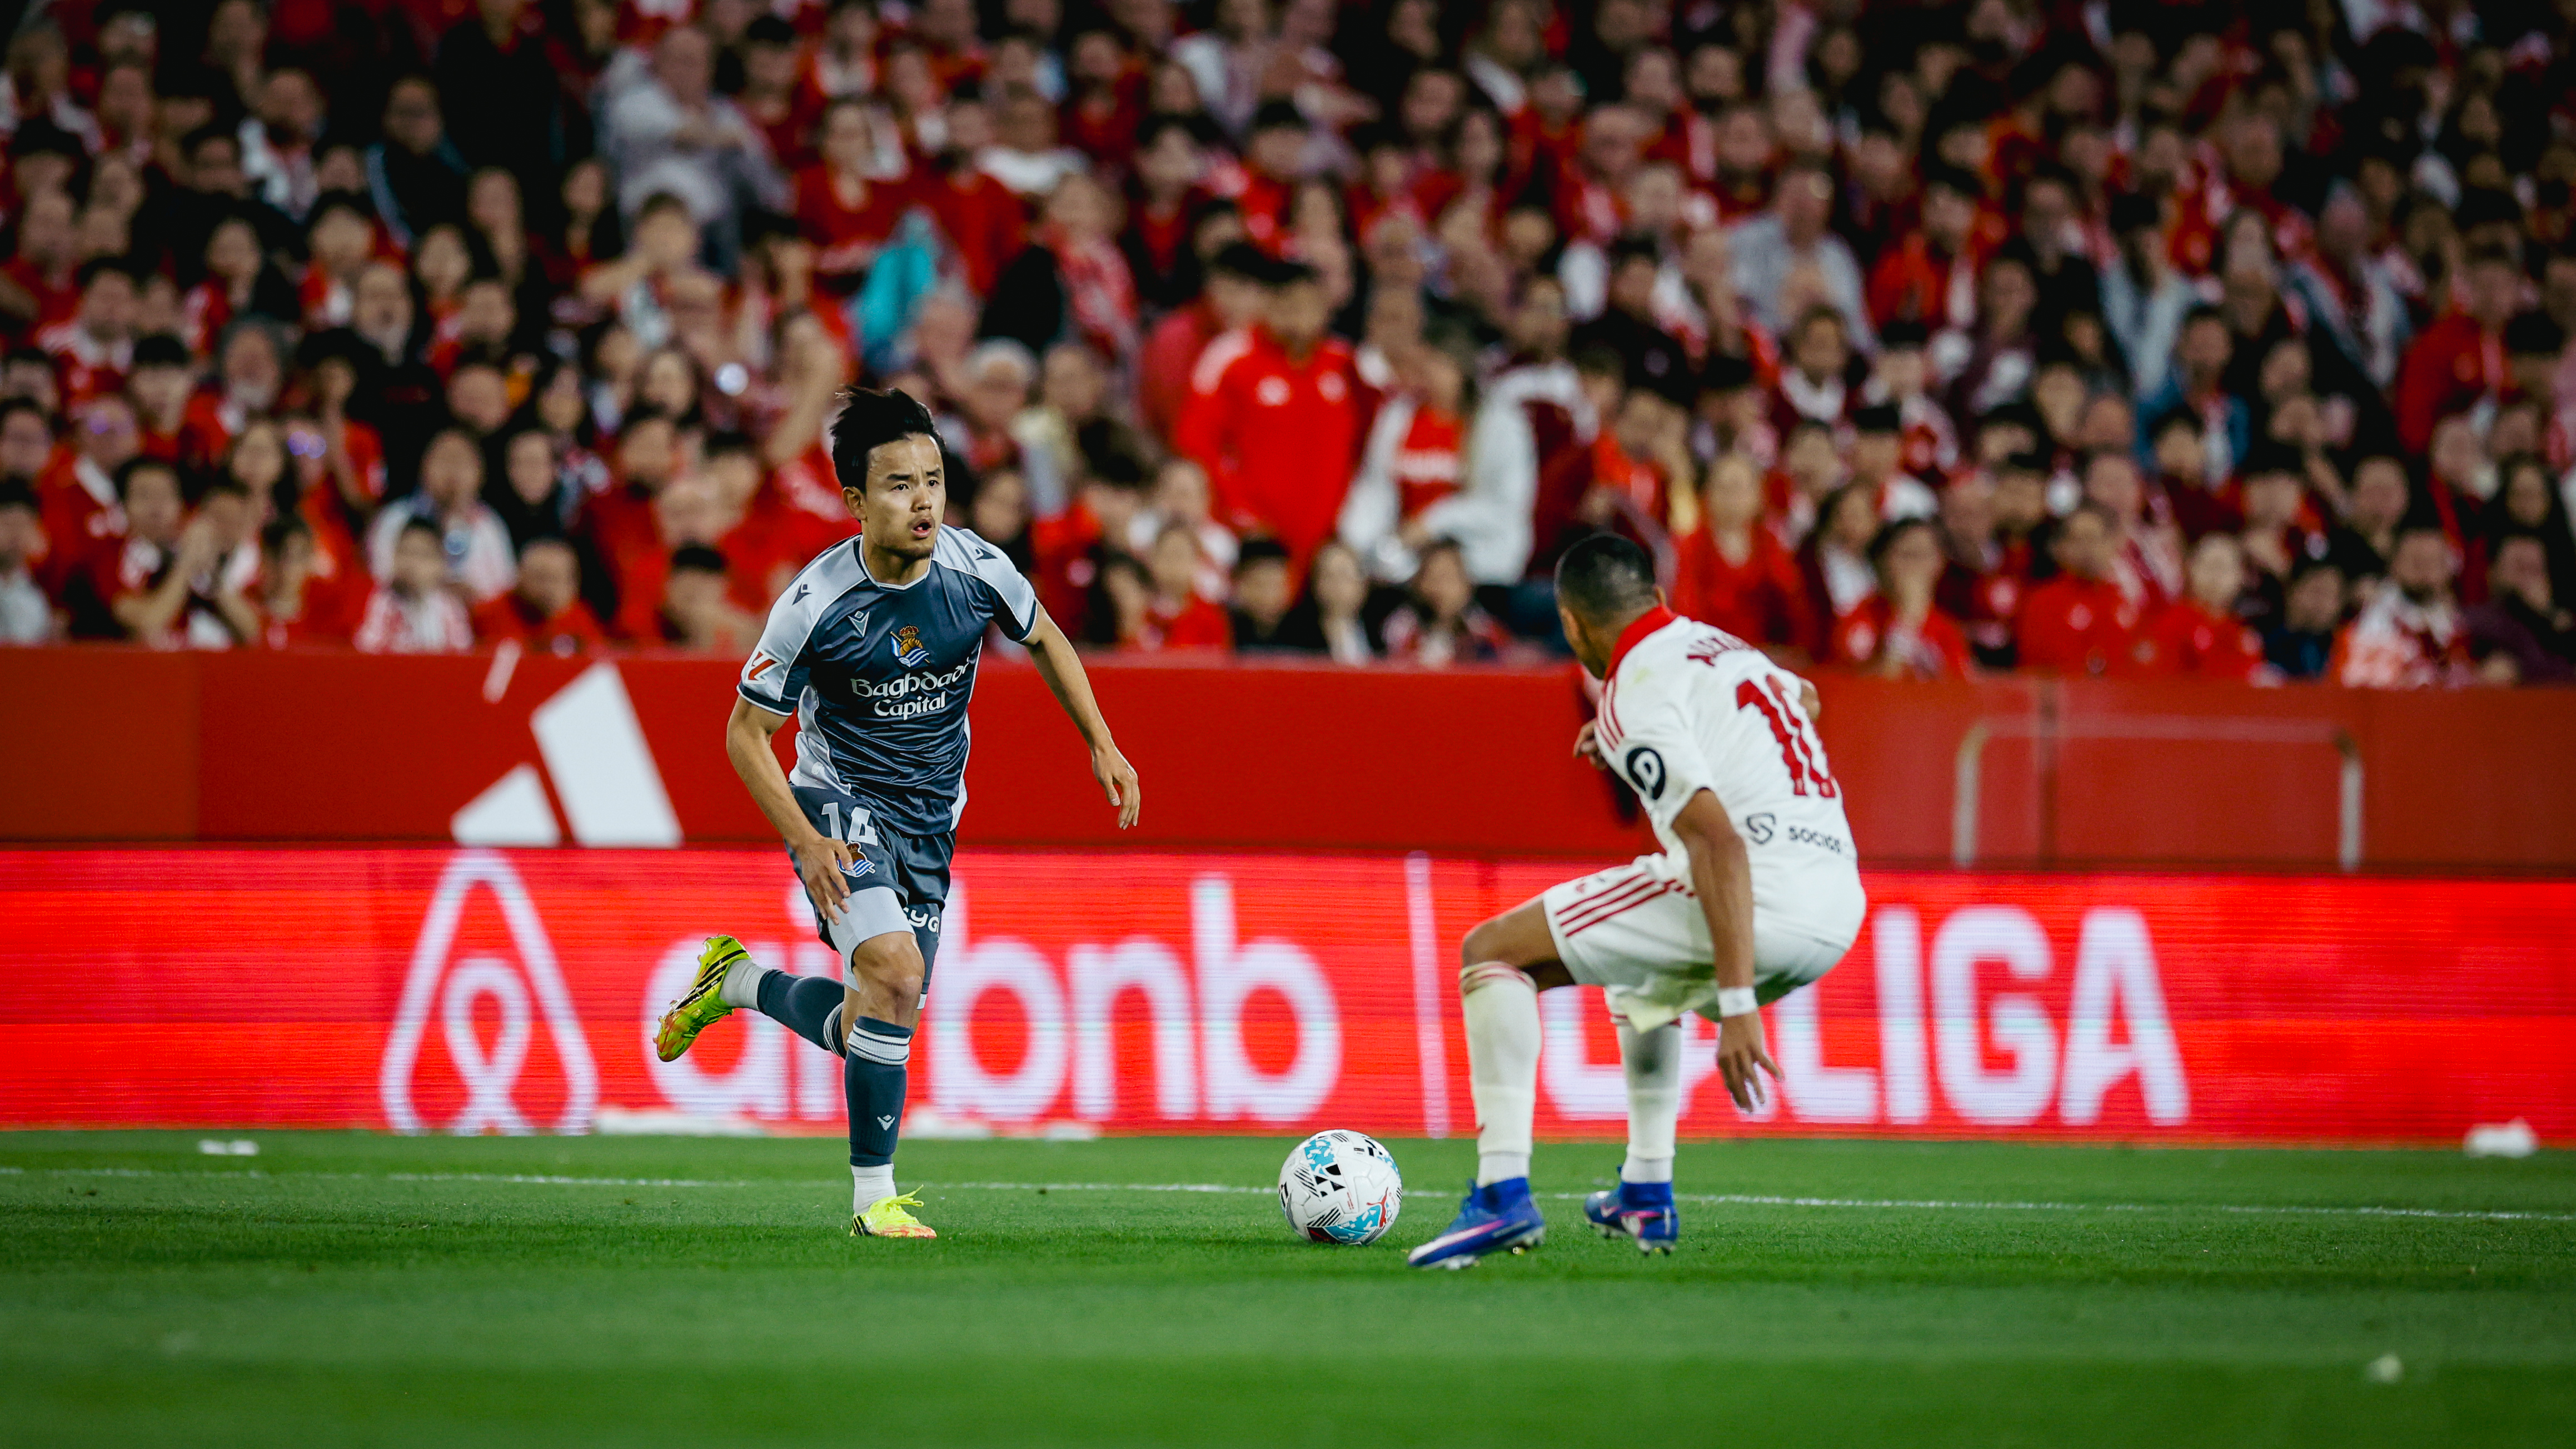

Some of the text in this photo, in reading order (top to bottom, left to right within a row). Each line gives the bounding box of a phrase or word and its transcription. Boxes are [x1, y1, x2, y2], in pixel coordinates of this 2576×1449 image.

[874, 691, 946, 721] Capital
[821, 802, 879, 846] 14
[645, 872, 1342, 1121] aibnb
